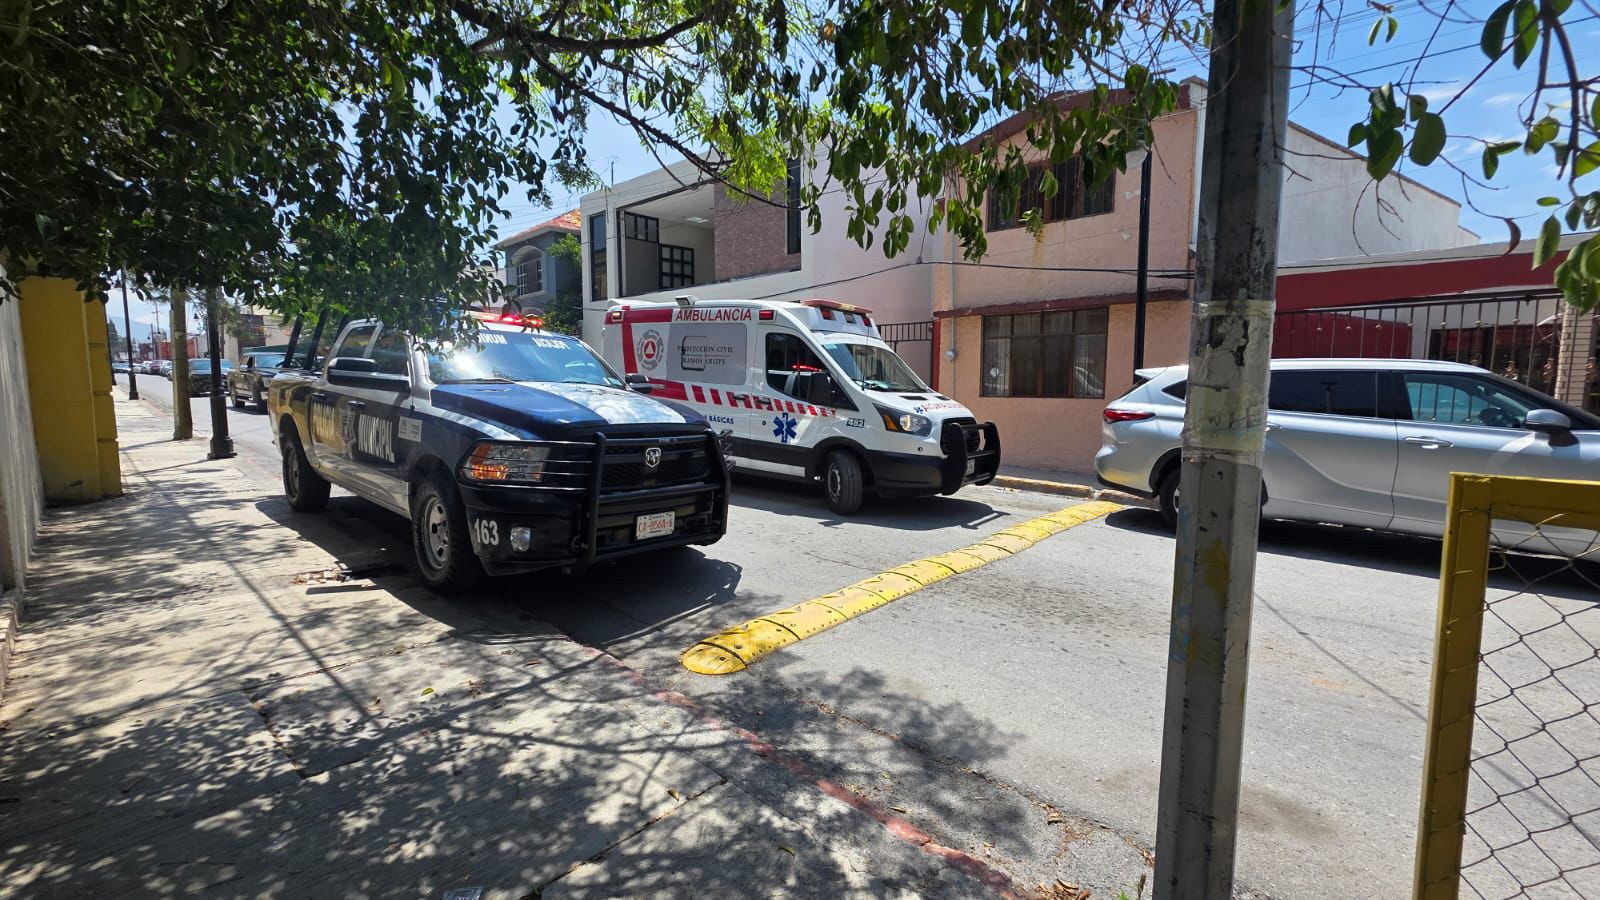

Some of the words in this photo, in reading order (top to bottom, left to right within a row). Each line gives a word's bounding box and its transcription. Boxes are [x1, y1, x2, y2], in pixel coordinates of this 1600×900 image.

[676, 309, 753, 321] AMBULANCIA
[716, 345, 734, 353] CIVIL
[847, 418, 864, 428] 482
[358, 413, 396, 464] MUNICIPAL
[474, 518, 499, 546] 163
